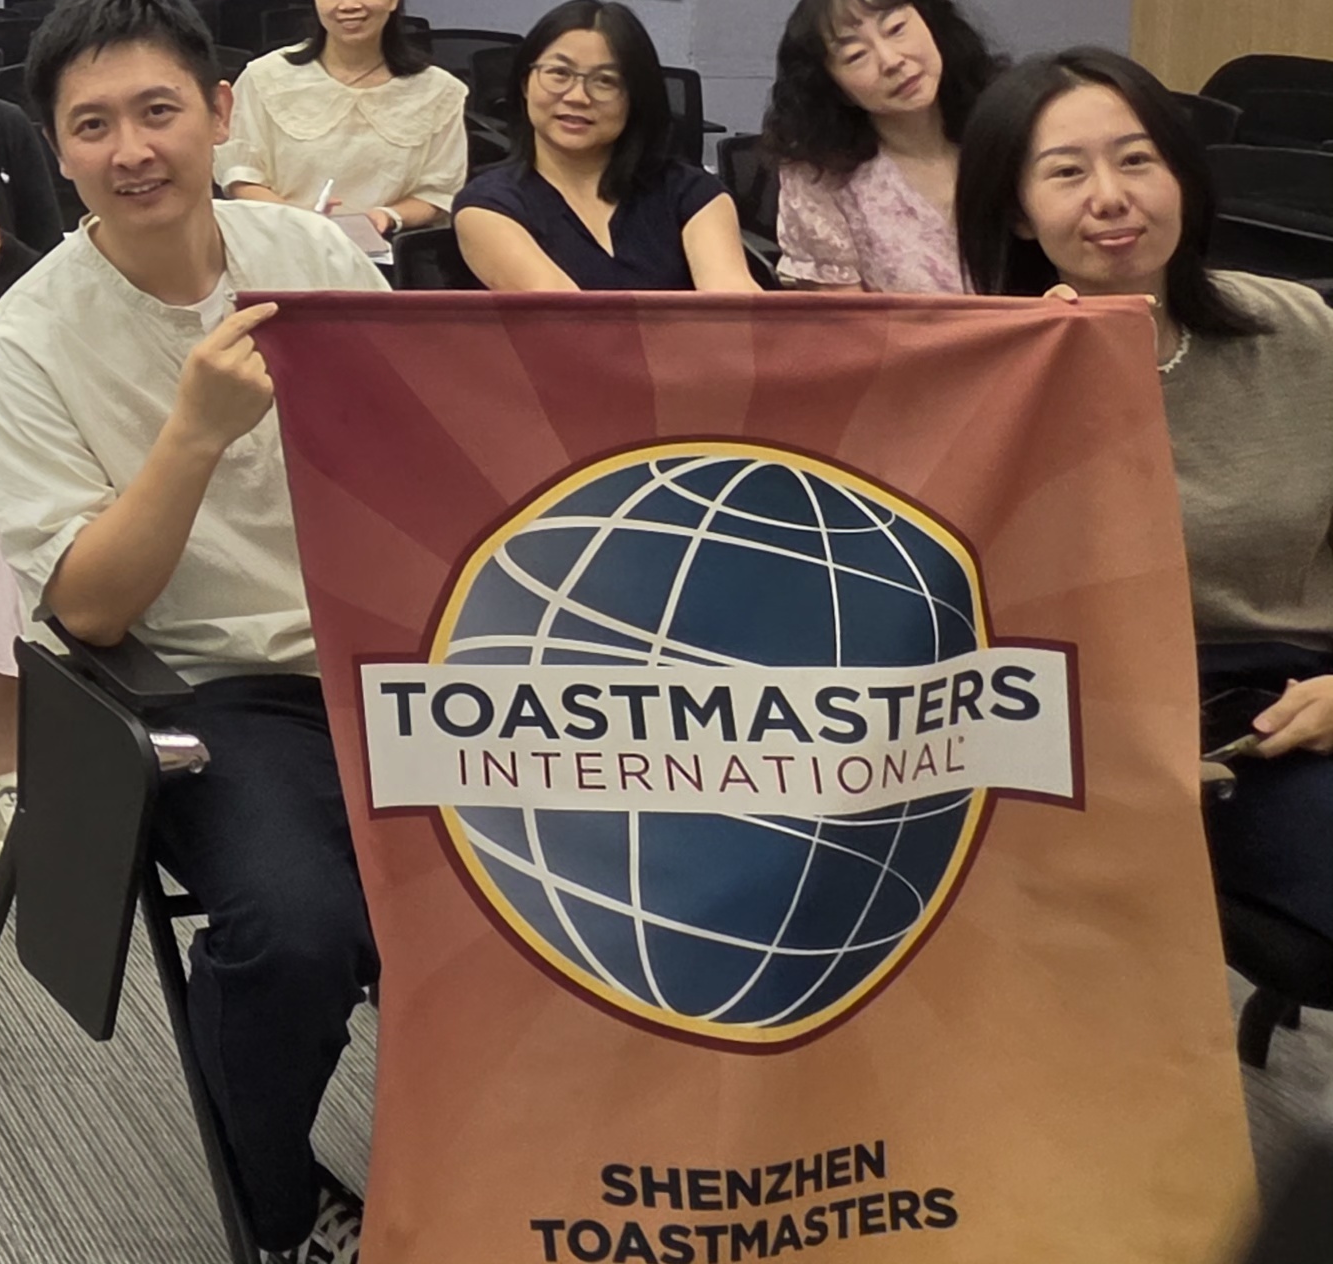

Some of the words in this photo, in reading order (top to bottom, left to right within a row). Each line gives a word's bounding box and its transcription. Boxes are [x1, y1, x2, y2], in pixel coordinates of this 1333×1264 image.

[380, 665, 1042, 744] TOASTMASTERS
[458, 737, 965, 796] INTERNATIONAL
[600, 1139, 886, 1211] SHENZHEN
[530, 1188, 959, 1264] TOASTMASTERS
